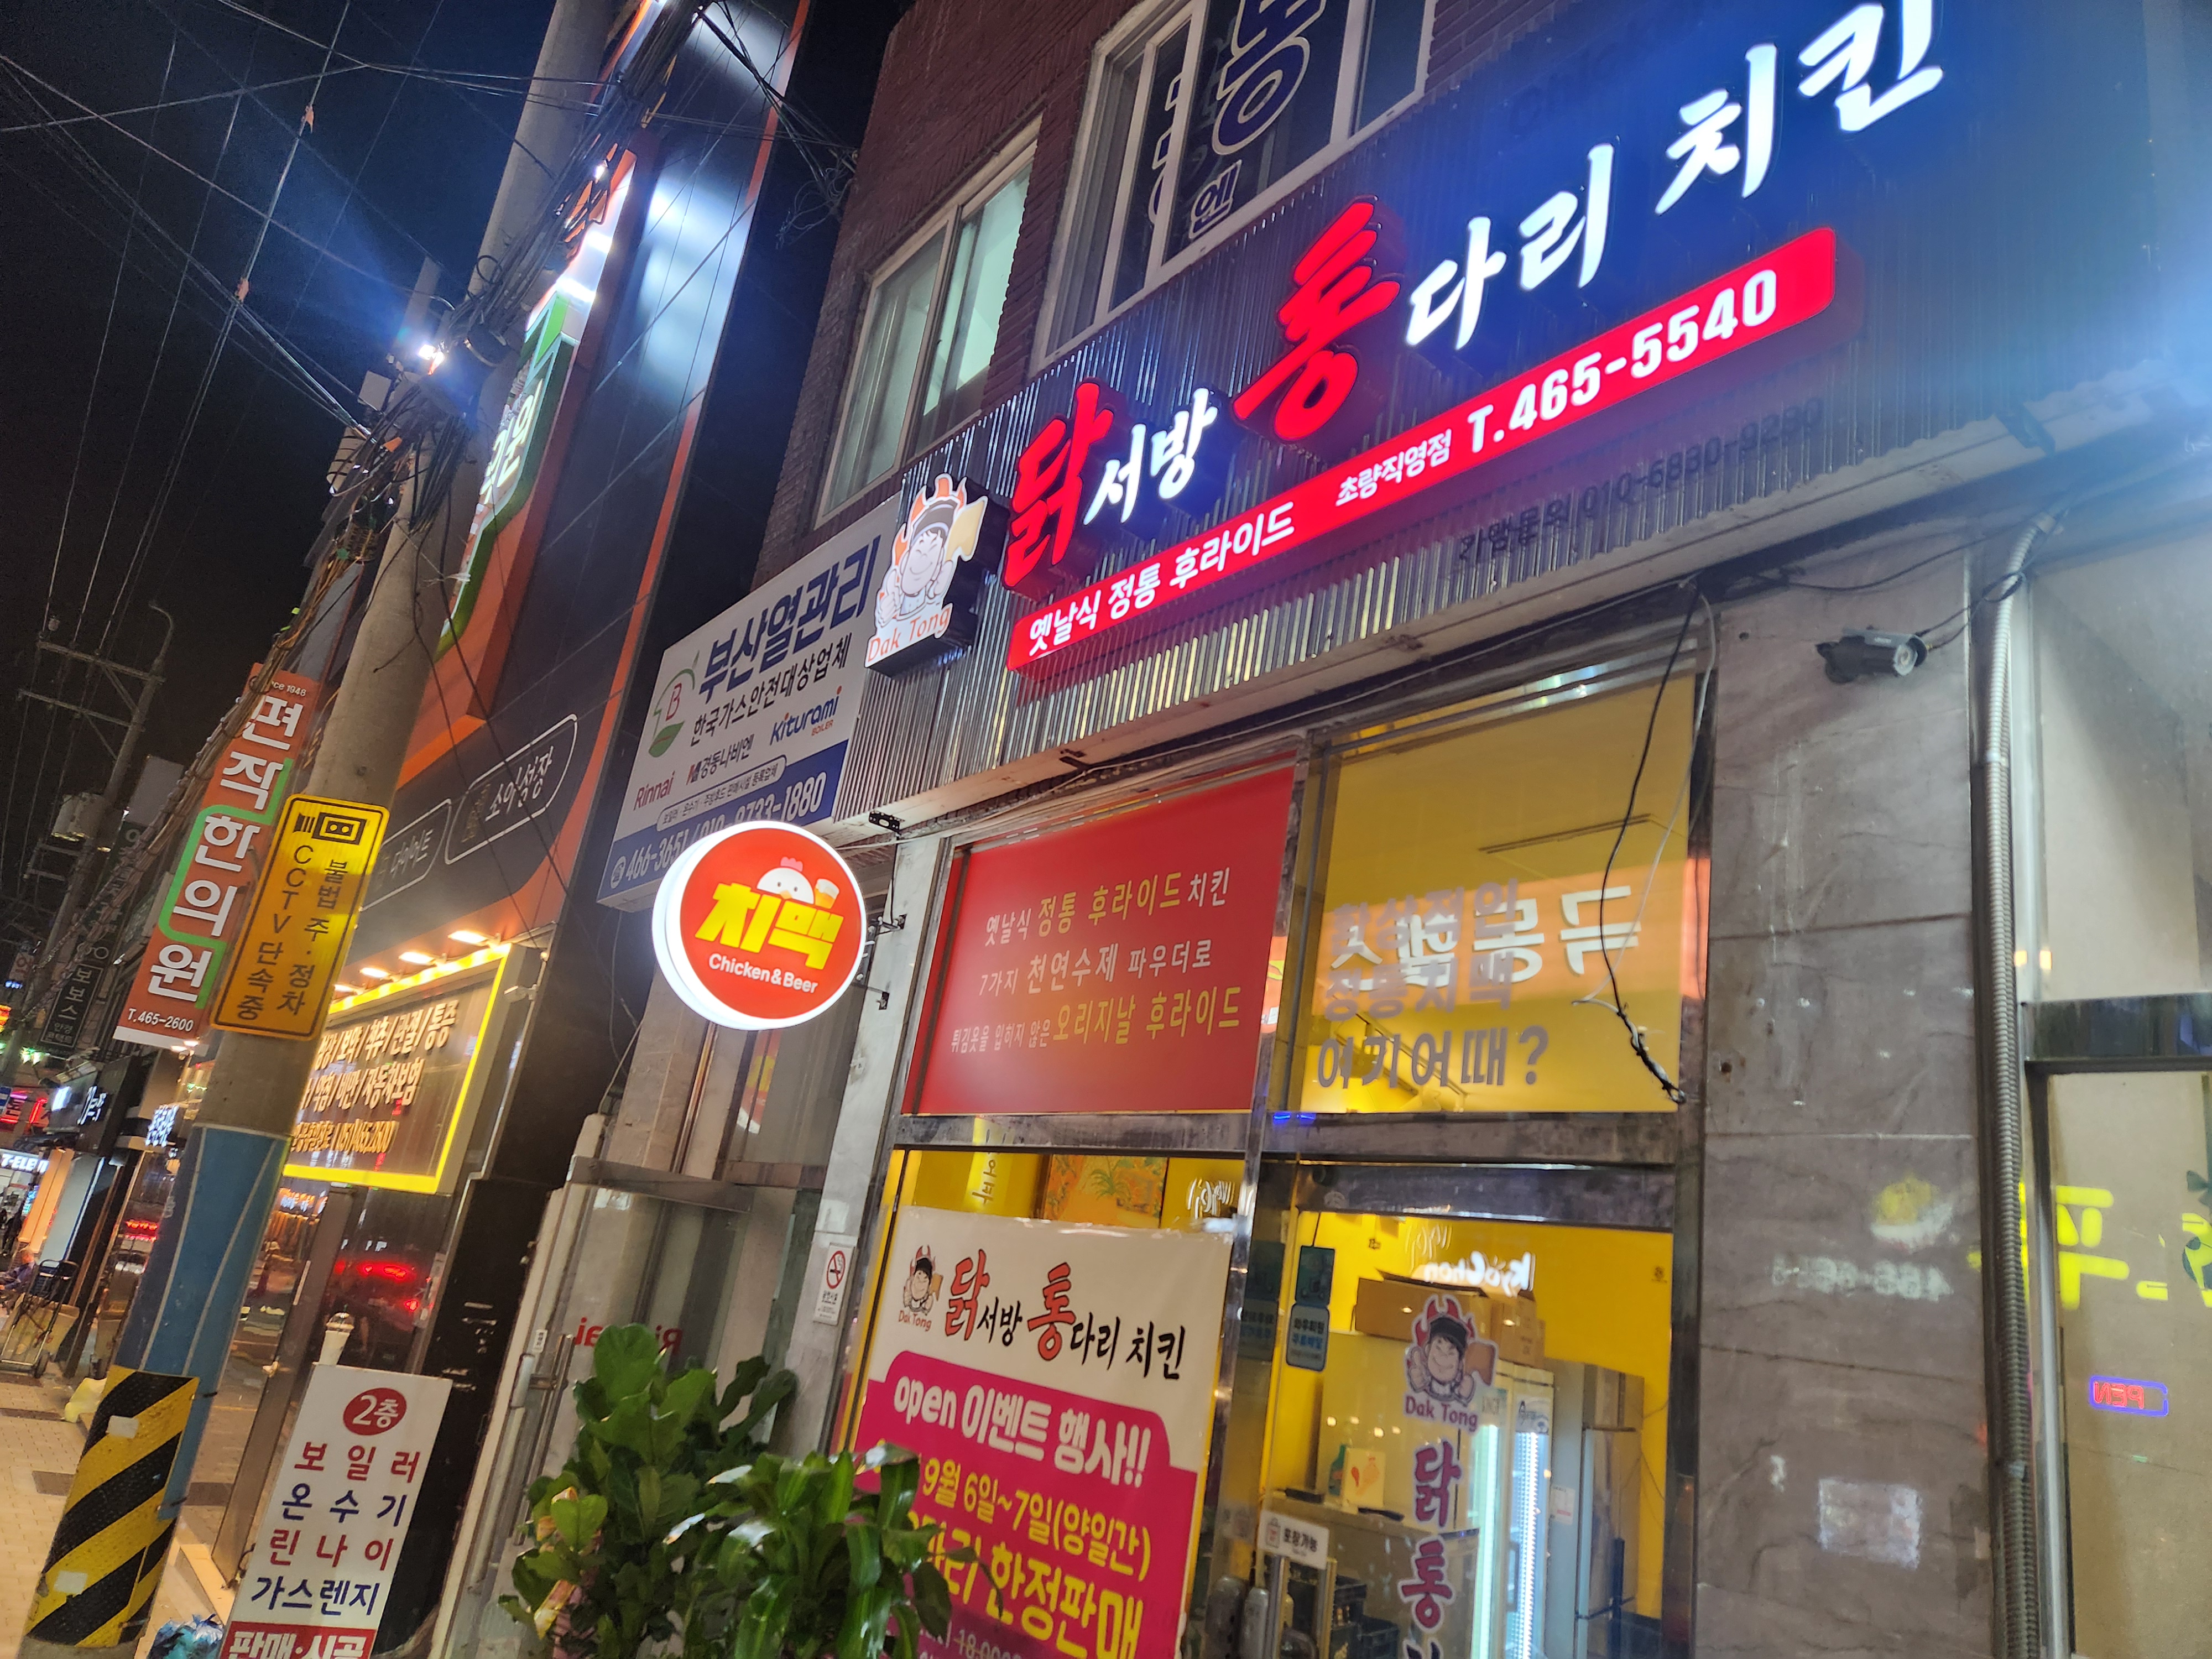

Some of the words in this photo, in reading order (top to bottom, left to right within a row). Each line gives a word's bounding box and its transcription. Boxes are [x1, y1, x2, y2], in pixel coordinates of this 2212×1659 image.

[1655, 0, 1944, 214] 치킨
[1029, 591, 1100, 656] 옛날식
[1108, 563, 1161, 619] 정통
[1170, 502, 1295, 589] 후라이드
[1335, 429, 1452, 507] 초량직영점
[698, 534, 881, 703] 부산열관리
[868, 627, 900, 662] Dak
[909, 607, 951, 640] Tong
[286, 685, 307, 697] 1948
[811, 720, 834, 737] BOILER
[701, 734, 754, 777] 경동나비엔
[633, 772, 675, 811] Rinnai
[317, 859, 348, 910] 불법
[984, 907, 1032, 947] 옛날식
[1037, 891, 1077, 938] 정통
[1088, 872, 1182, 926] 후라이드
[1187, 867, 1230, 907] 치킨
[694, 881, 844, 970] 치맥
[978, 968, 1019, 997] 7가지
[1026, 942, 1119, 995] 천연수제
[1126, 939, 1212, 979] 파우더로
[58, 967, 93, 1020] 보보스
[128, 1008, 194, 1032] T.465-2600
[950, 1024, 990, 1053] 튀김옷을
[994, 1021, 1026, 1050] 입히지
[1028, 1018, 1051, 1049] 않은
[1052, 995, 1136, 1045] 오리지날
[1146, 985, 1241, 1040] 후라이드
[911, 1312, 933, 1332] Tong
[945, 1248, 1023, 1348] 닭서방
[1125, 1320, 1186, 1381] 치킨
[352, 1394, 400, 1430] 2층
[893, 1375, 958, 1430] open
[961, 1384, 1052, 1462] 이벤트
[1405, 1395, 1435, 1420] Dak
[1441, 1402, 1479, 1433] Tong
[294, 1441, 421, 1484] 보일러
[924, 1457, 959, 1506] 9월
[281, 1482, 408, 1528] 온수기
[269, 1528, 394, 1572] 린나이
[251, 1575, 382, 1616] 가스렌지
[985, 1540, 1145, 1659] 한정판매
